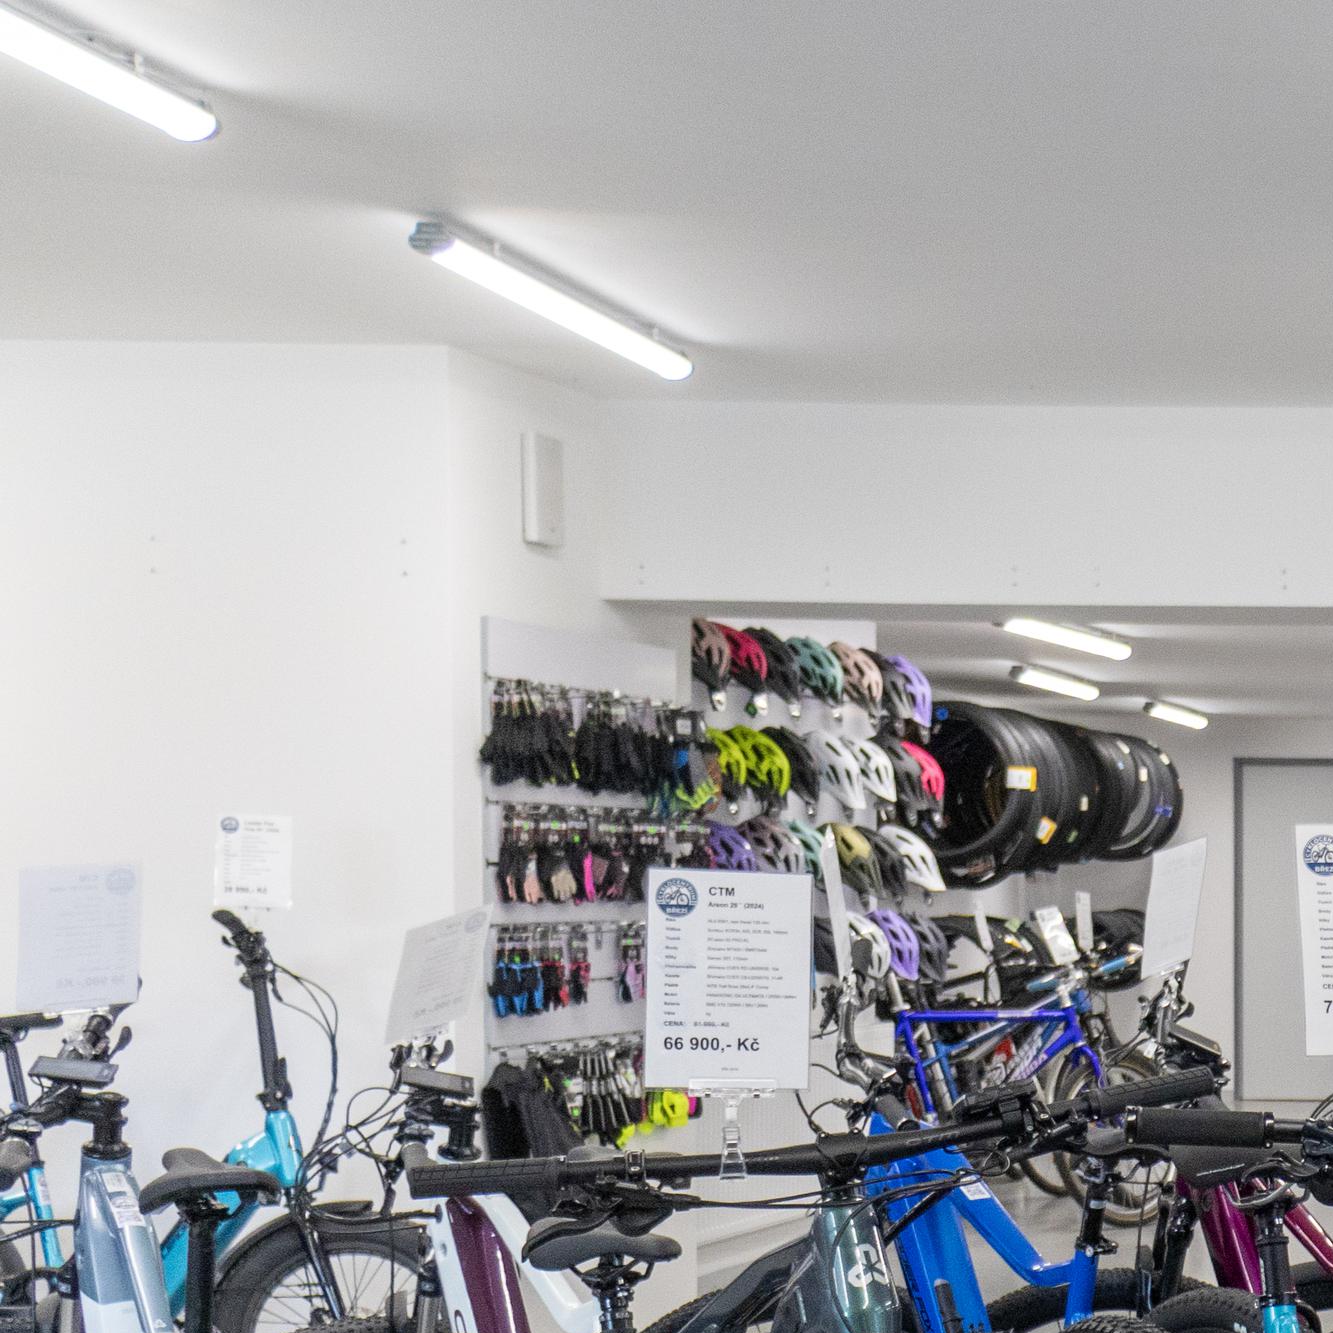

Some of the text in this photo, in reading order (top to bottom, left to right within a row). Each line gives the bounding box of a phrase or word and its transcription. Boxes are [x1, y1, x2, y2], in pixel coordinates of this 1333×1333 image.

[709, 887, 735, 896] CTM
[664, 1037, 760, 1053] 66 900,- Kč
